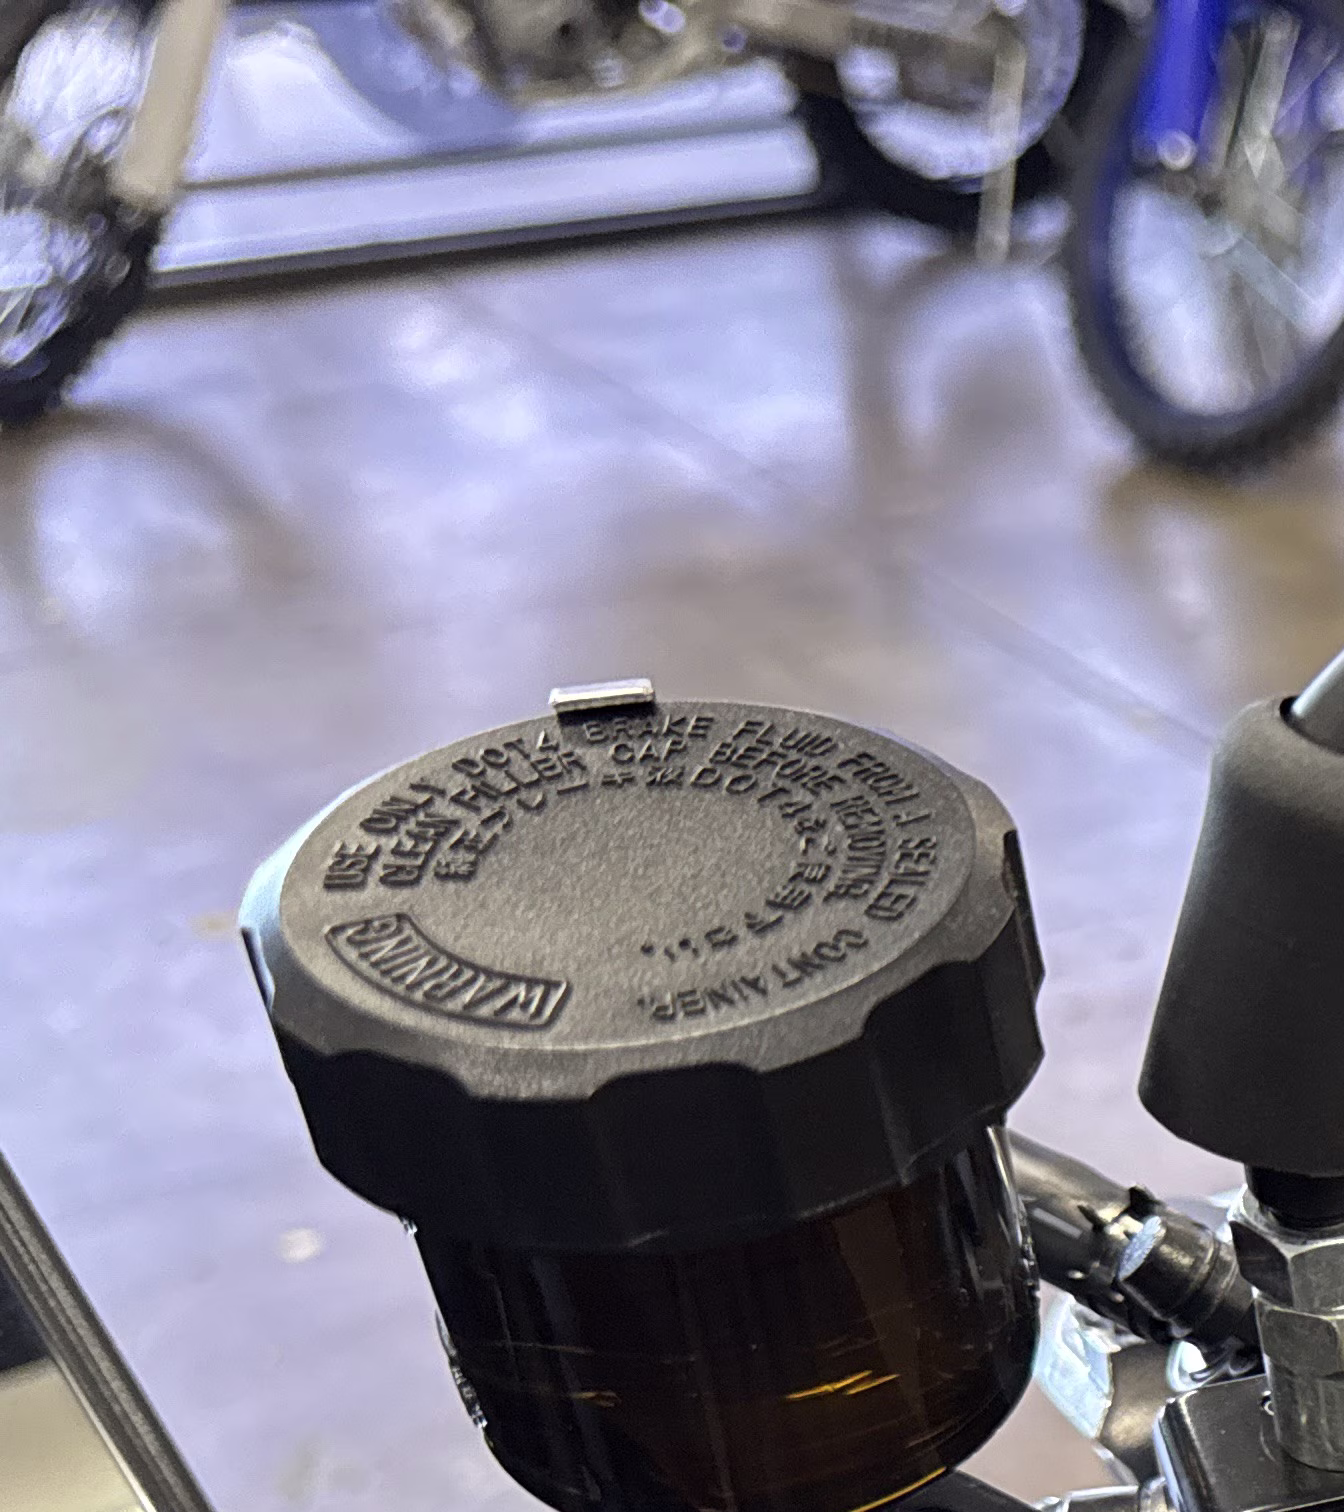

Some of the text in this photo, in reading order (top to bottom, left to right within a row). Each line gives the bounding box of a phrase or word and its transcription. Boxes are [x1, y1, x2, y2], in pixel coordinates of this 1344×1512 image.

[583, 713, 715, 744] BRAKE
[731, 718, 838, 758] FLUID
[359, 777, 447, 833] ONLY
[836, 752, 921, 806] FROM
[379, 811, 461, 888] CLEAN
[449, 750, 588, 813] FILLER
[608, 739, 688, 765] CAP
[708, 741, 847, 797] BEFORE
[323, 841, 382, 889] USE
[863, 835, 938, 922] SEALED
[346, 918, 554, 1020] WARNING
